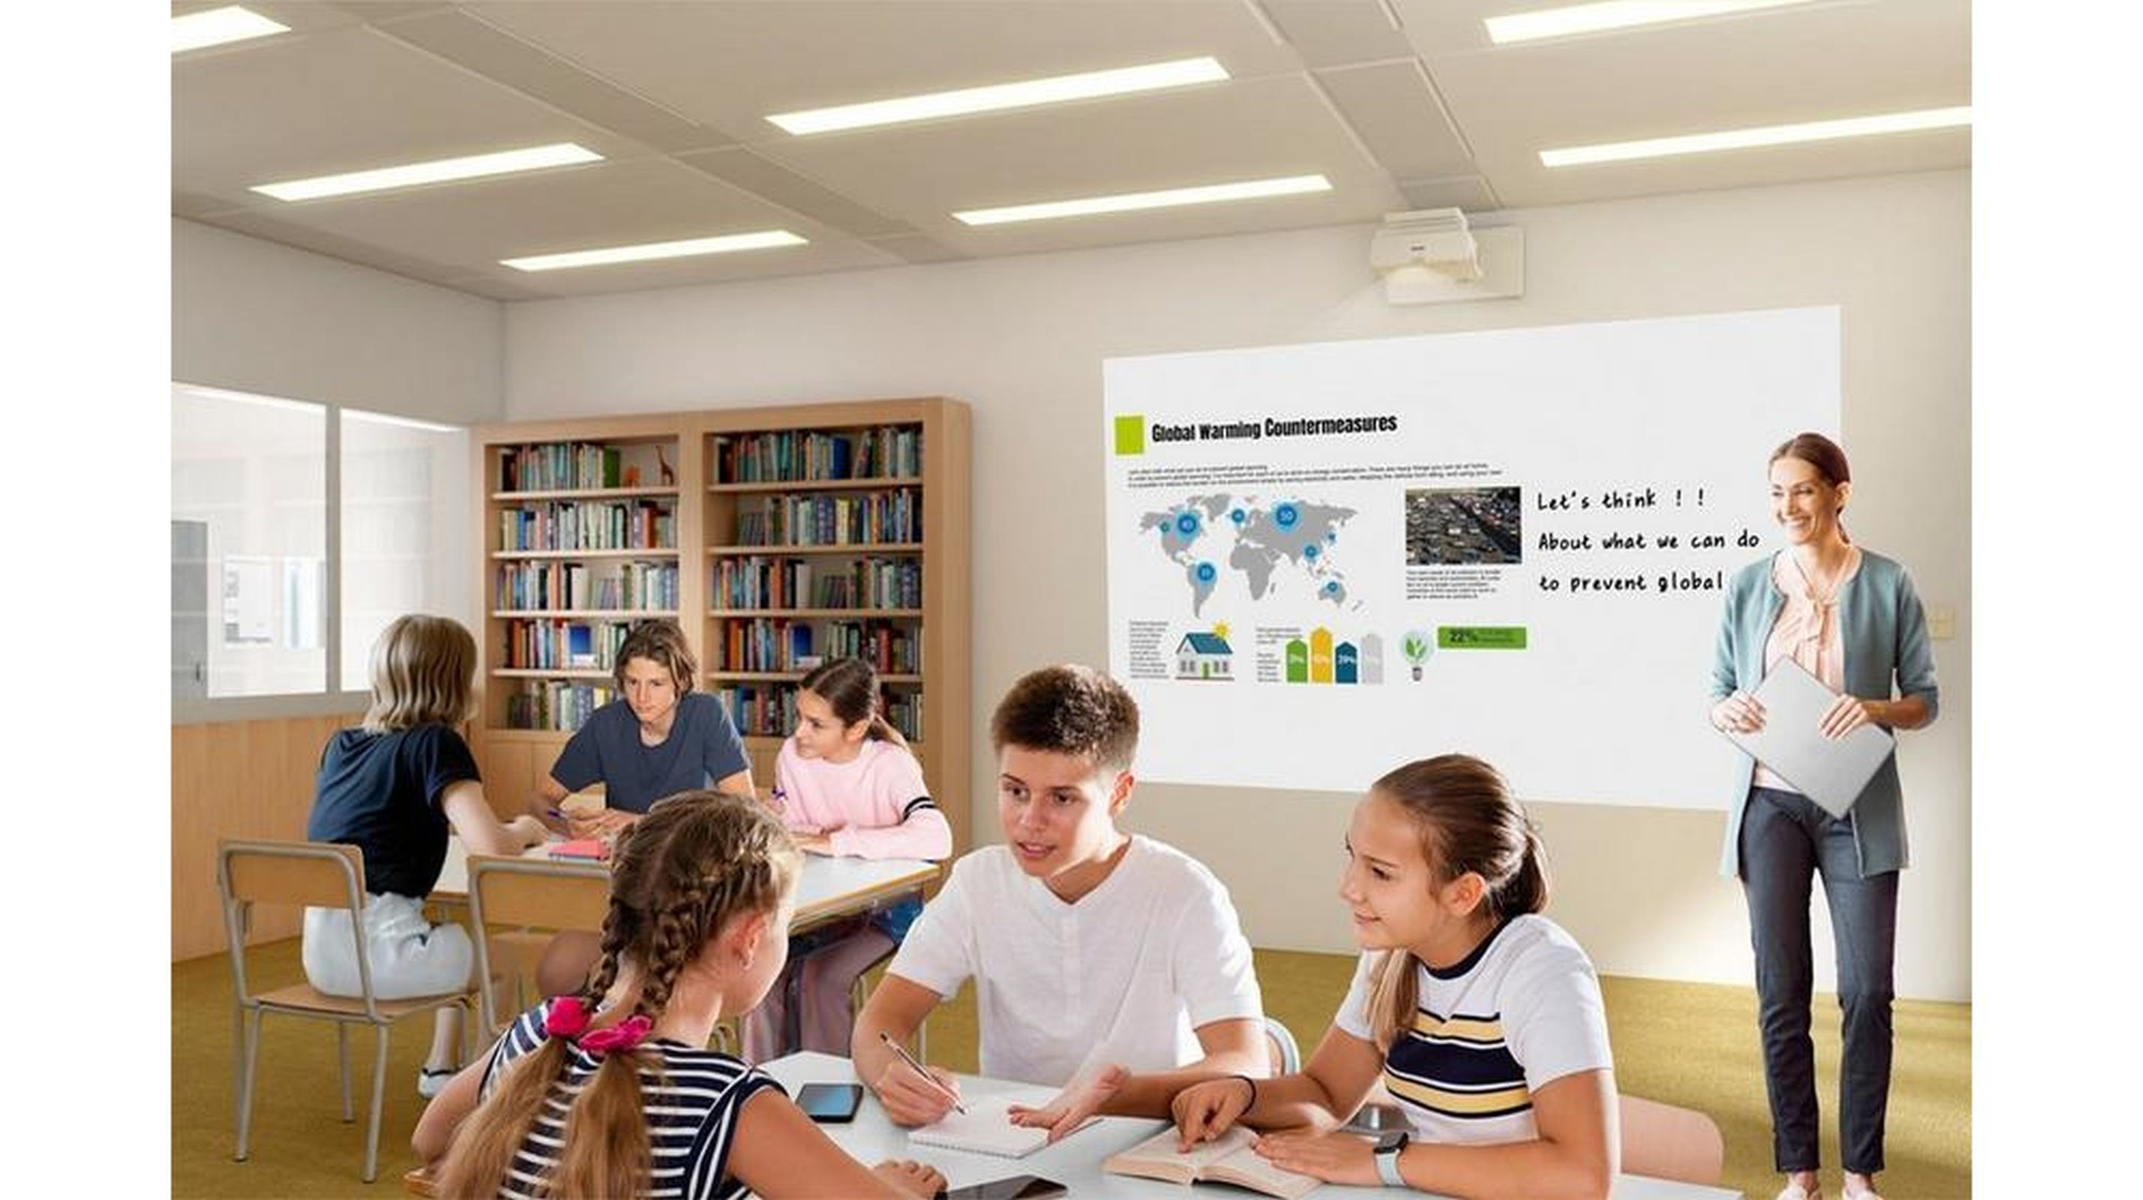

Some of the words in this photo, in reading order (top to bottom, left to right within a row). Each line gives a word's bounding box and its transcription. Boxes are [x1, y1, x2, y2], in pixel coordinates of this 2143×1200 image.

[1152, 423, 1195, 442] Global
[1199, 421, 1261, 441] Warming
[1265, 415, 1397, 437] Countermeasures
[1537, 490, 1590, 511] Let's
[1602, 488, 1656, 509] think
[1538, 532, 1592, 551] About
[1602, 531, 1647, 550] what
[1657, 535, 1679, 549] we
[1690, 535, 1726, 549] can
[1736, 528, 1760, 548] do
[1539, 576, 1560, 591] to
[1570, 574, 1647, 593] prevent
[1657, 570, 1724, 593] global
